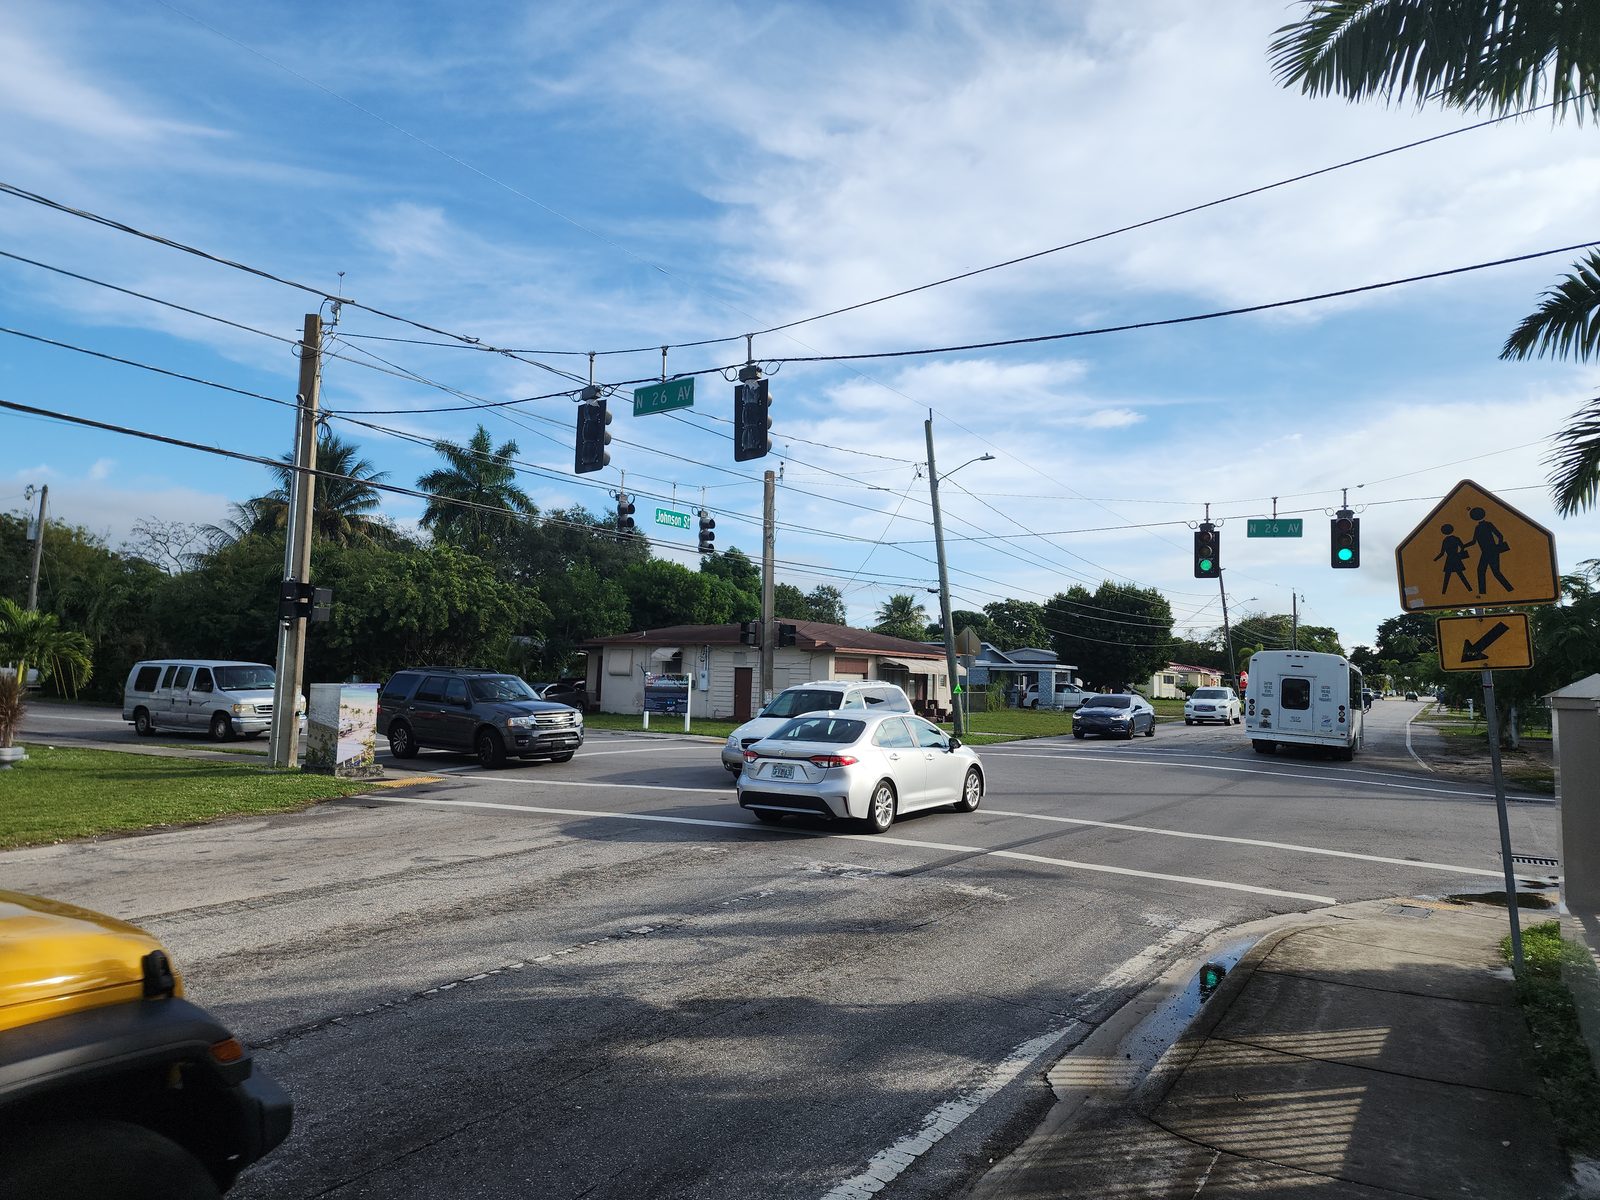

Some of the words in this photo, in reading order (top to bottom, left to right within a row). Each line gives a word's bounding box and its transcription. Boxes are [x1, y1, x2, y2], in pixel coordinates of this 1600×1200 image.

[636, 395, 643, 409] N
[652, 391, 667, 406] 26
[677, 385, 691, 401] AV
[656, 510, 682, 526] Johnson
[683, 515, 690, 528] St
[1249, 524, 1256, 533] N
[1265, 524, 1279, 533] 26
[1288, 523, 1299, 533] AV
